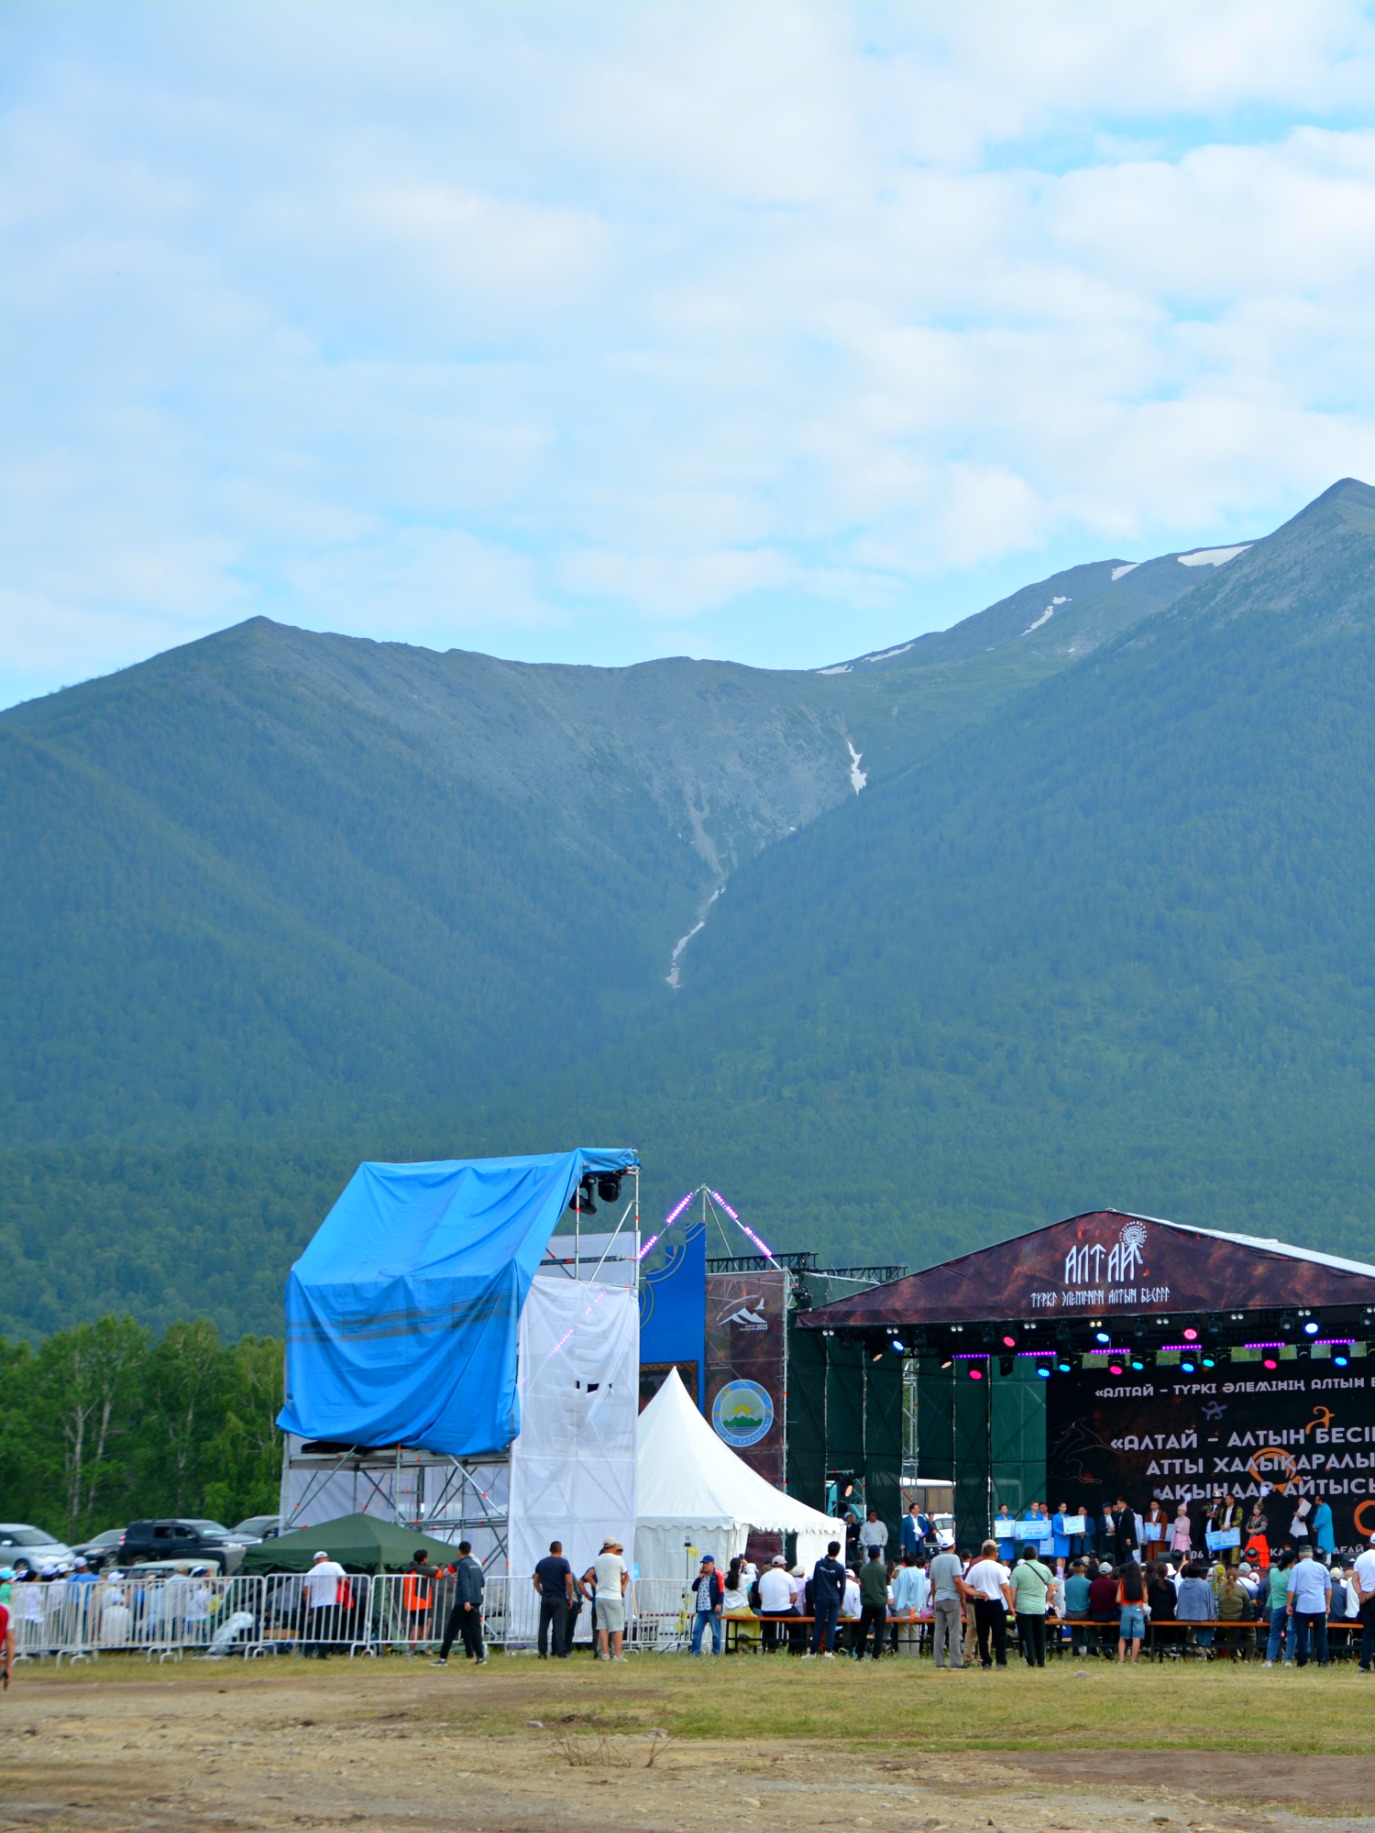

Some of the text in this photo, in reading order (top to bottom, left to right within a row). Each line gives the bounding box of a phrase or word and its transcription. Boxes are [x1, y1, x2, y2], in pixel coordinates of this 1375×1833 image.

[1095, 1384, 1154, 1398] «АЛТАЙ
[1173, 1383, 1217, 1396] ТҮРКІ
[1222, 1379, 1305, 1394] ӘЛЕМІНІҢ
[1311, 1377, 1364, 1390] АЛТЫН
[1110, 1429, 1198, 1451] «АЛТАЙ
[1227, 1428, 1305, 1447] АЛТЫН
[1146, 1458, 1204, 1475] АТТЫ
